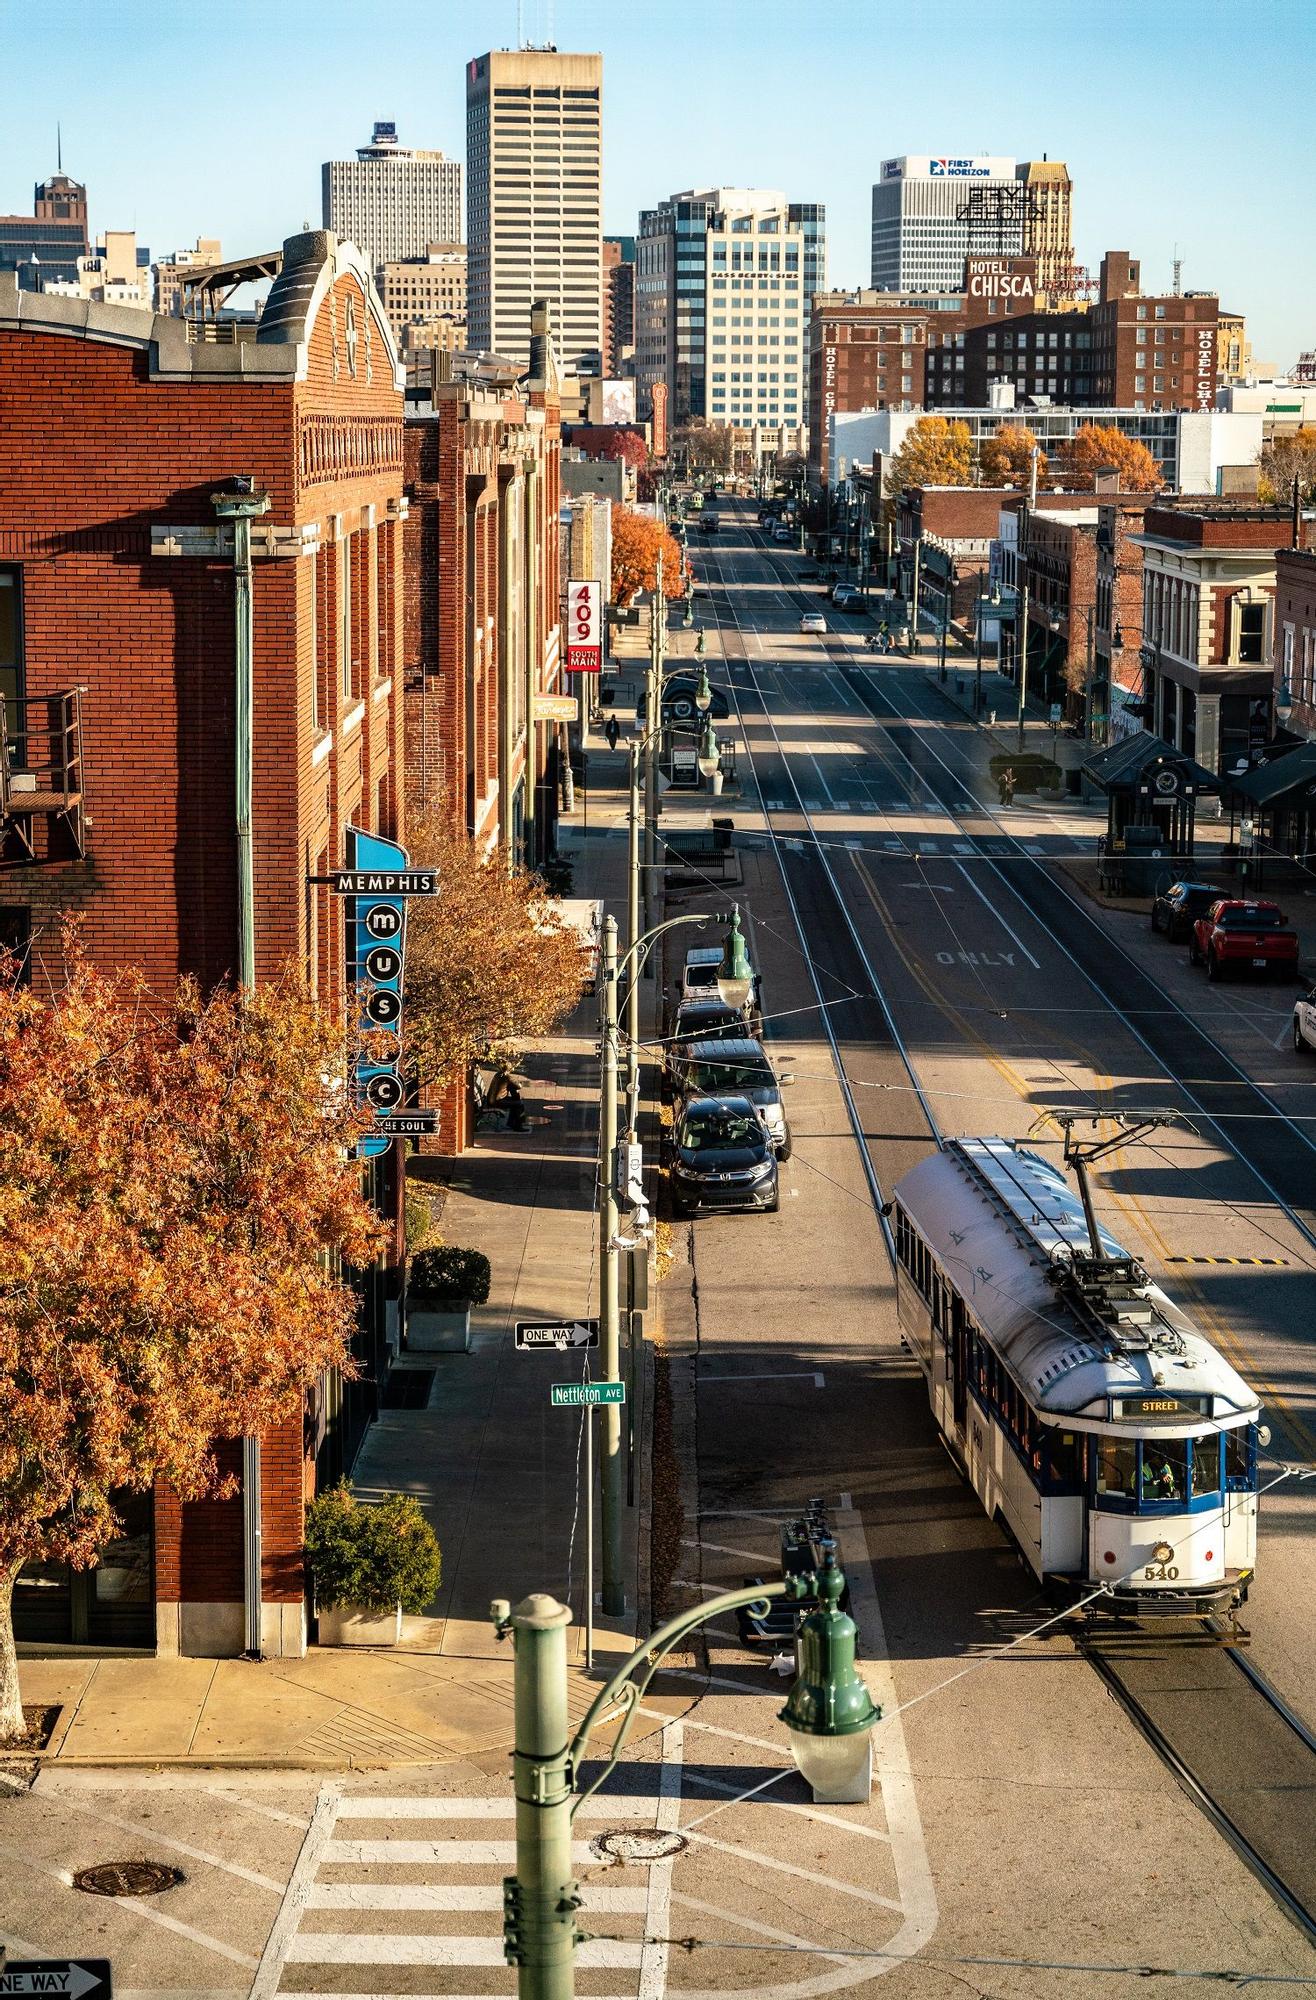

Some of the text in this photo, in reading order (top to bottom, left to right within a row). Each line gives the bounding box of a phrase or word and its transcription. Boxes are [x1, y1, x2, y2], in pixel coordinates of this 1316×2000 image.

[948, 160, 974, 168] FIRST
[948, 168, 990, 176] HORIZON
[970, 262, 1005, 274] HOTEL
[971, 276, 1034, 297] CHISCA
[826, 347, 836, 387] HOTEL
[1197, 330, 1213, 413] HOTEL CHI
[576, 585, 592, 641] 409
[570, 658, 597, 666] MAIN
[338, 876, 431, 890] MEMPHIS
[935, 952, 1015, 966] ONLY
[400, 1121, 426, 1131] SOUL
[526, 1329, 574, 1340] ONE WAY
[555, 1386, 622, 1403] Nettleton AVE
[1142, 1401, 1178, 1411] STREET
[1144, 1565, 1180, 1581] 540
[0, 1974, 69, 1992] NE WAY
